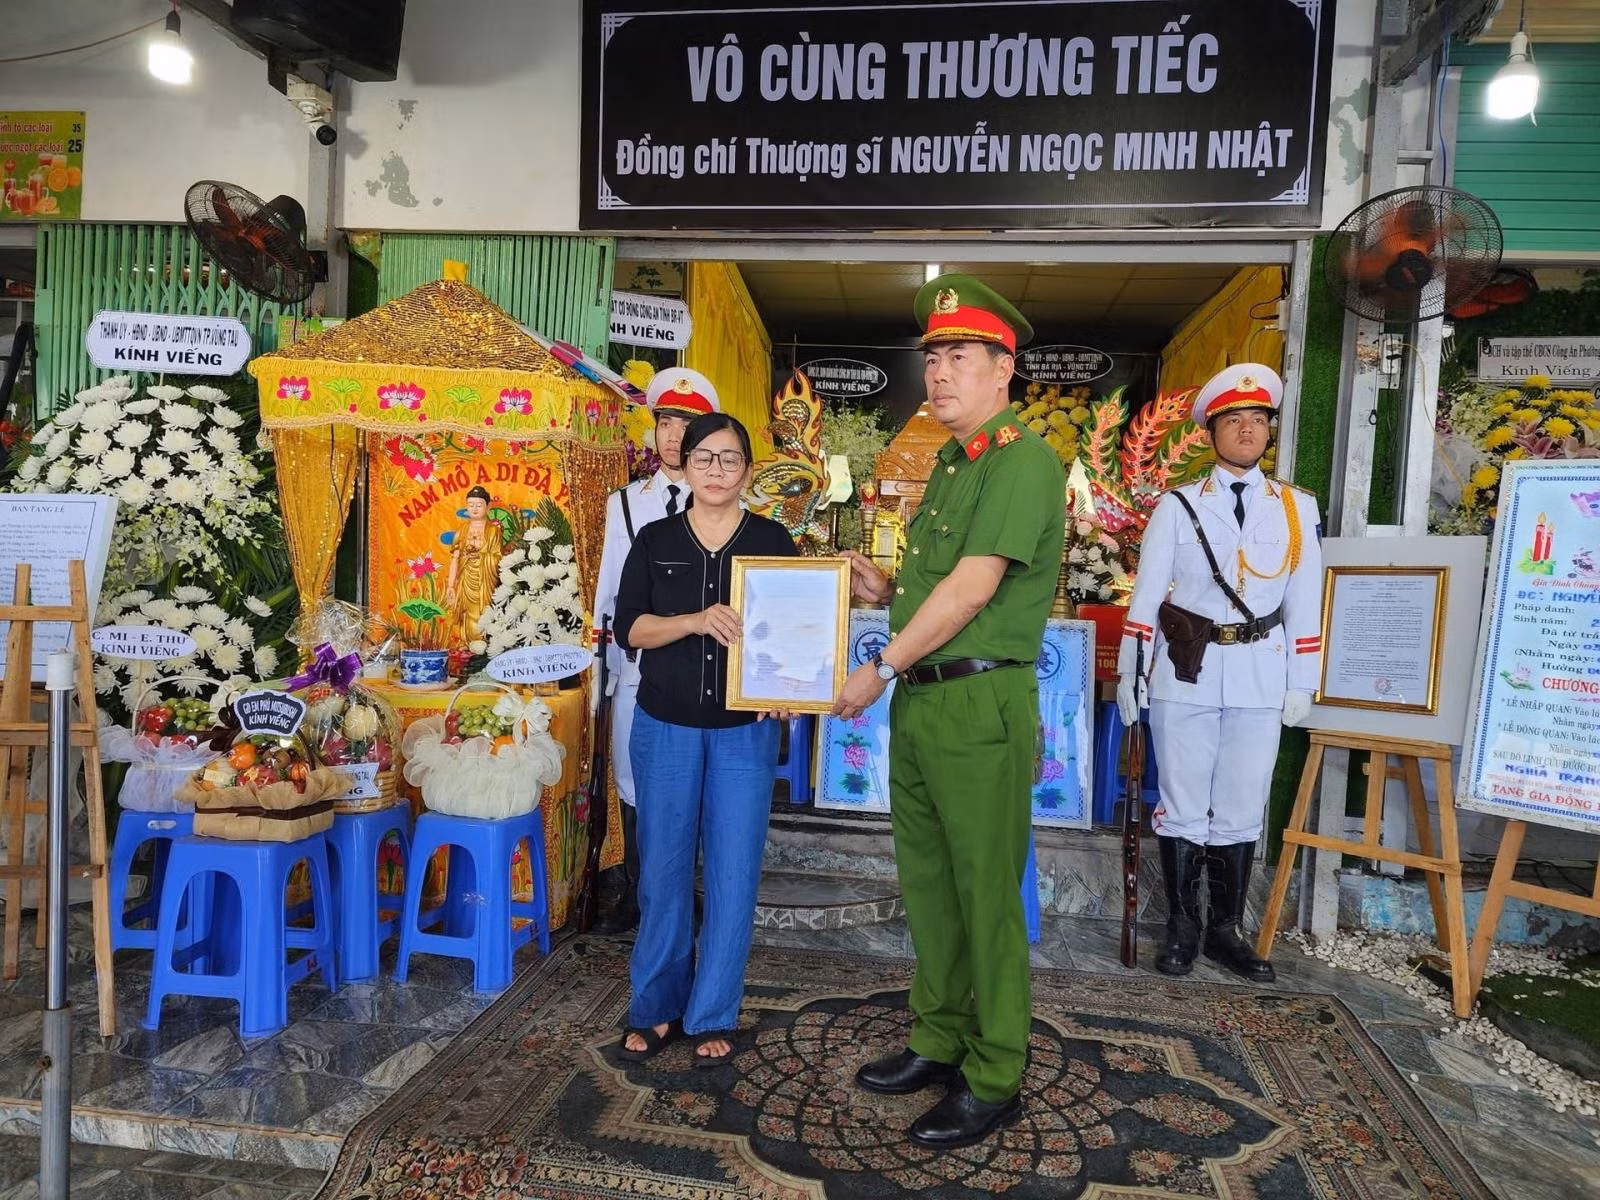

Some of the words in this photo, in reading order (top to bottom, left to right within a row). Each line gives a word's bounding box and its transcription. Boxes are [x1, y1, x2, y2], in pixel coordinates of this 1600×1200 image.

[688, 34, 743, 102] VÔ
[760, 32, 885, 101] CÙNG
[903, 33, 1094, 98] THƯƠNG
[1112, 15, 1218, 94] TIẾC
[72, 124, 81, 132] 35
[68, 139, 82, 152] 25
[616, 134, 684, 178] Đồng
[694, 137, 737, 174] chí
[746, 138, 846, 181] Thượng
[856, 134, 881, 172] sĩ
[891, 121, 1010, 173] NGUYỄN
[1020, 133, 1103, 180] NGỌC
[1113, 131, 1195, 170] MINH
[1206, 121, 1293, 179] NHẬT
[631, 323, 675, 341] VIẾNG
[114, 345, 159, 362] KÍNH
[166, 347, 222, 366] VIẾNG
[1501, 365, 1539, 376] Kính
[1545, 363, 1592, 377] Viếng
[398, 485, 441, 528] NAM
[439, 464, 471, 497] MÔ
[475, 464, 493, 485] A
[495, 462, 520, 483] DI
[523, 463, 553, 496] ĐÀ
[1513, 614, 1537, 623] Sinh
[141, 634, 152, 643] E.
[1548, 639, 1580, 651] Ngày
[1542, 677, 1599, 694] CHƯƠNG
[249, 712, 268, 726] KÍNH
[1492, 784, 1525, 797] TANG
[1529, 789, 1551, 803] GIA
